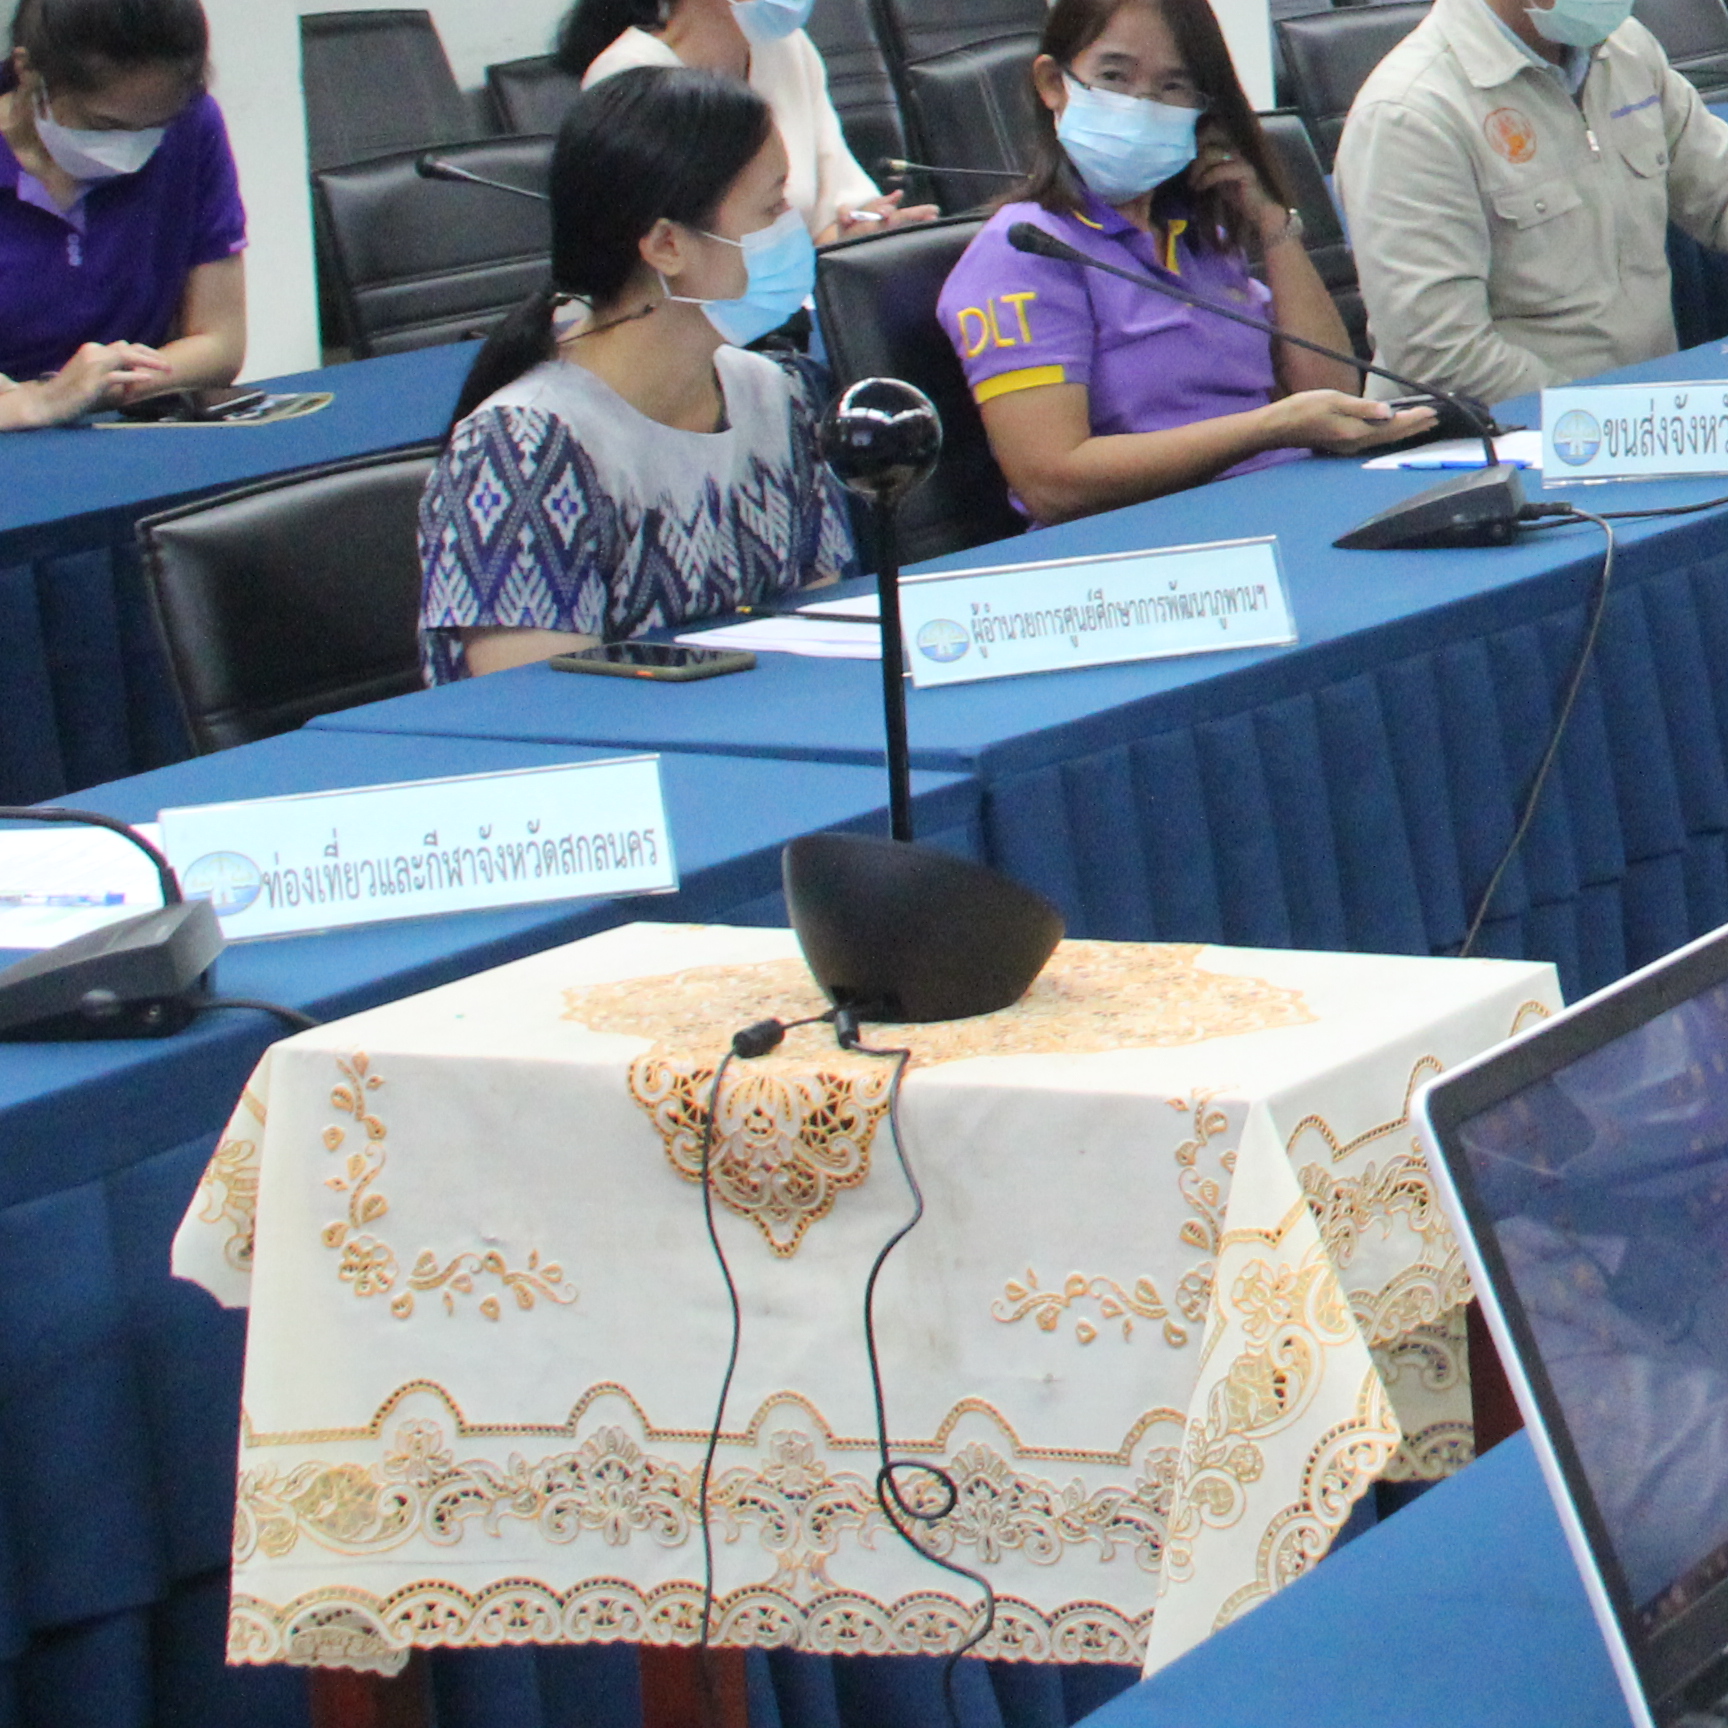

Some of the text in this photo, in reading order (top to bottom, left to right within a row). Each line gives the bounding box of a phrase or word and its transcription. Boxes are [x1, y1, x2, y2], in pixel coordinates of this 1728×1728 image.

[956, 291, 1037, 359] DLT
[262, 817, 659, 911] ท่องเที่ยวและกีฬาจังหวัดสกลนคร
